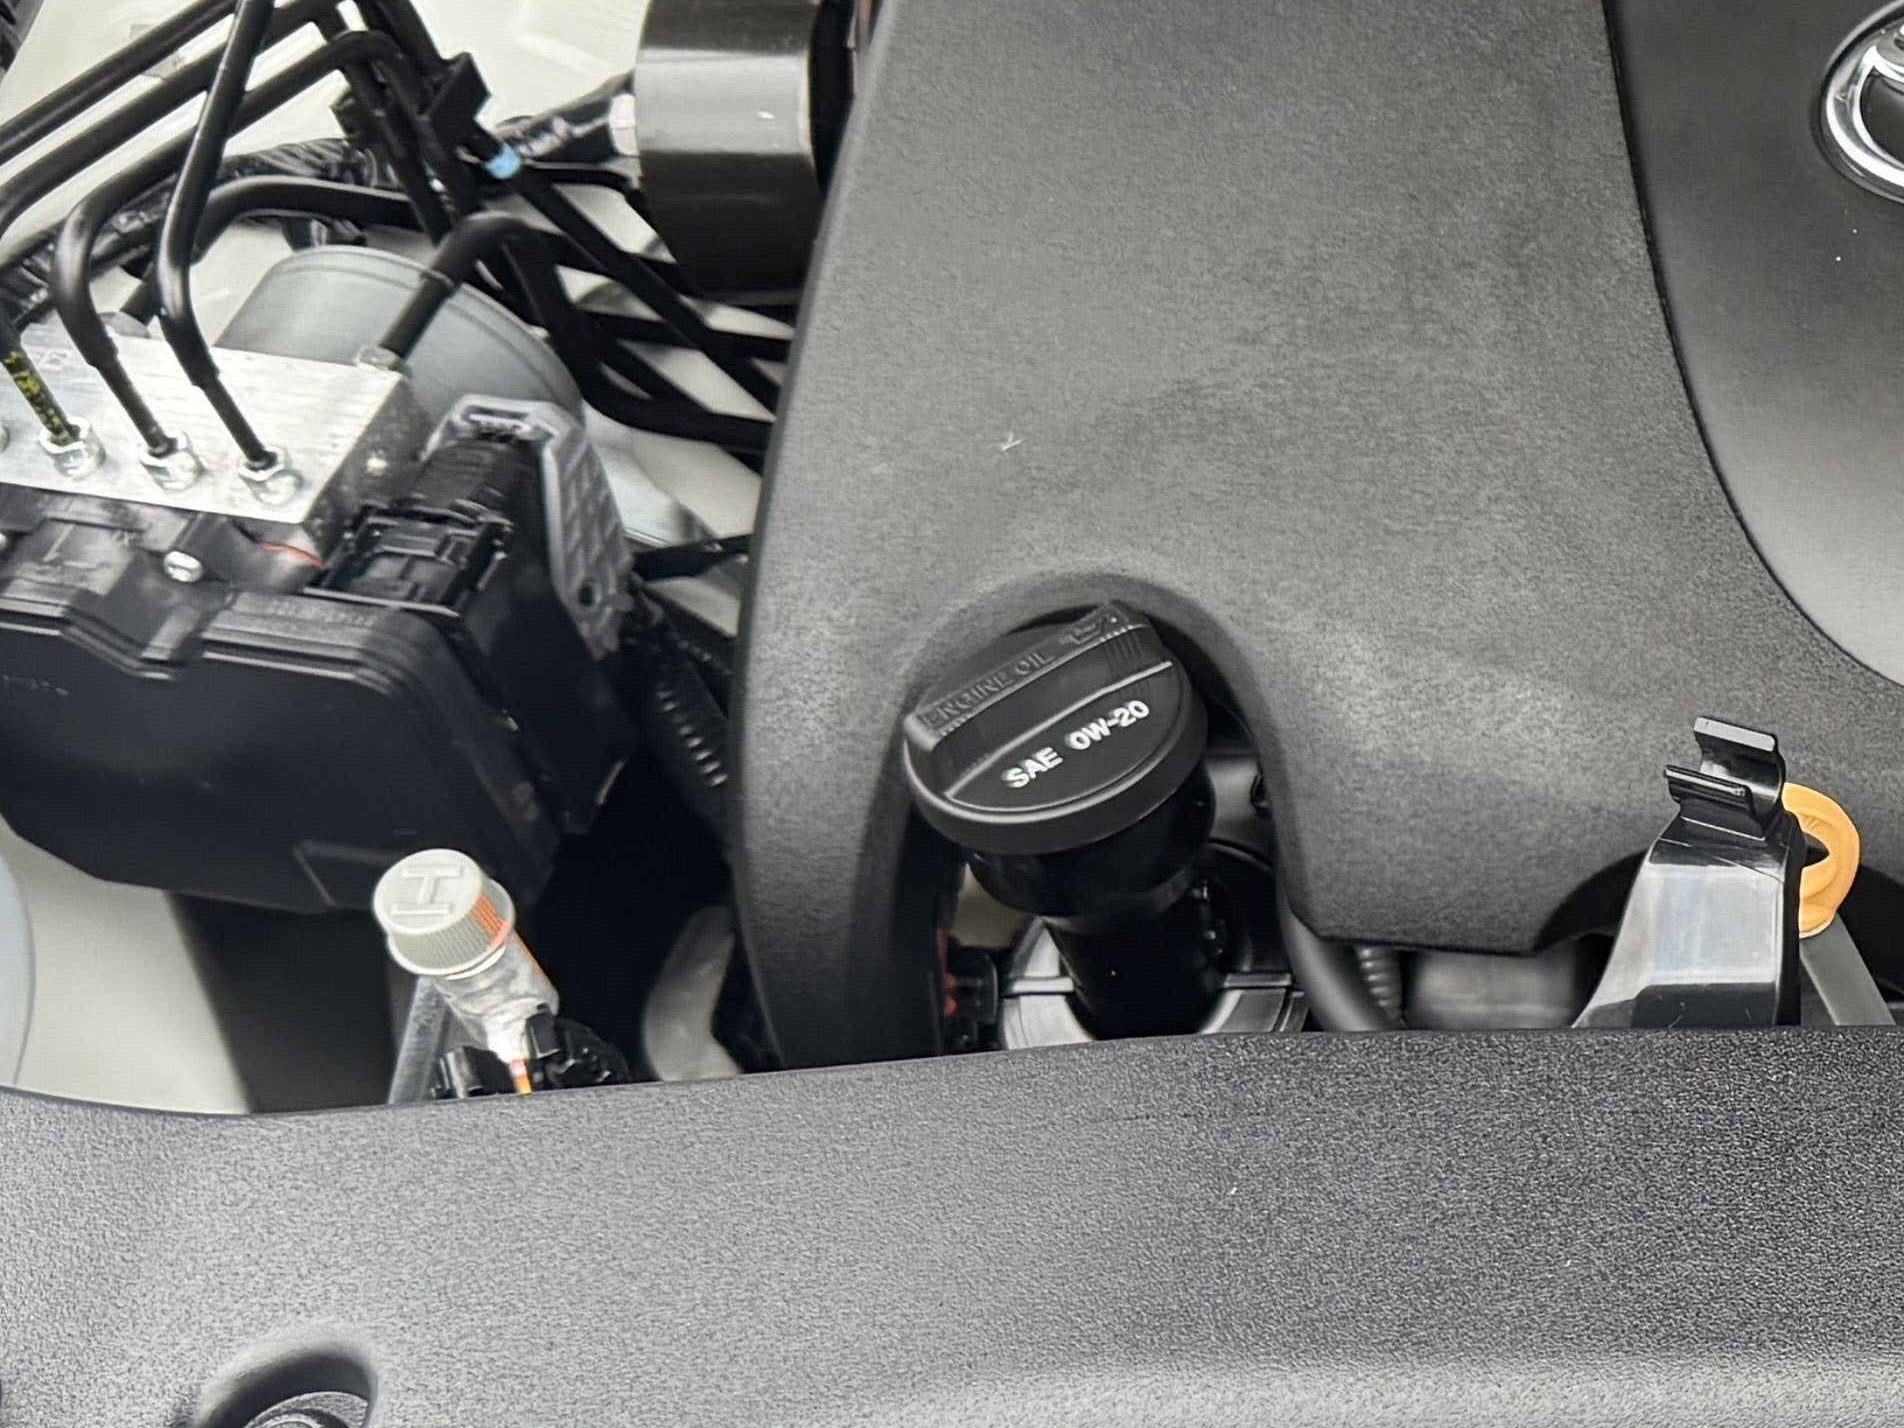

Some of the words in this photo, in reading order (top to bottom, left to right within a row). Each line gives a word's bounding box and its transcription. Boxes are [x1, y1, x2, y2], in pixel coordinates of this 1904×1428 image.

[1013, 650, 1058, 677] OIL
[1001, 746, 1064, 789] SAE
[1065, 699, 1150, 751] 0W-20
